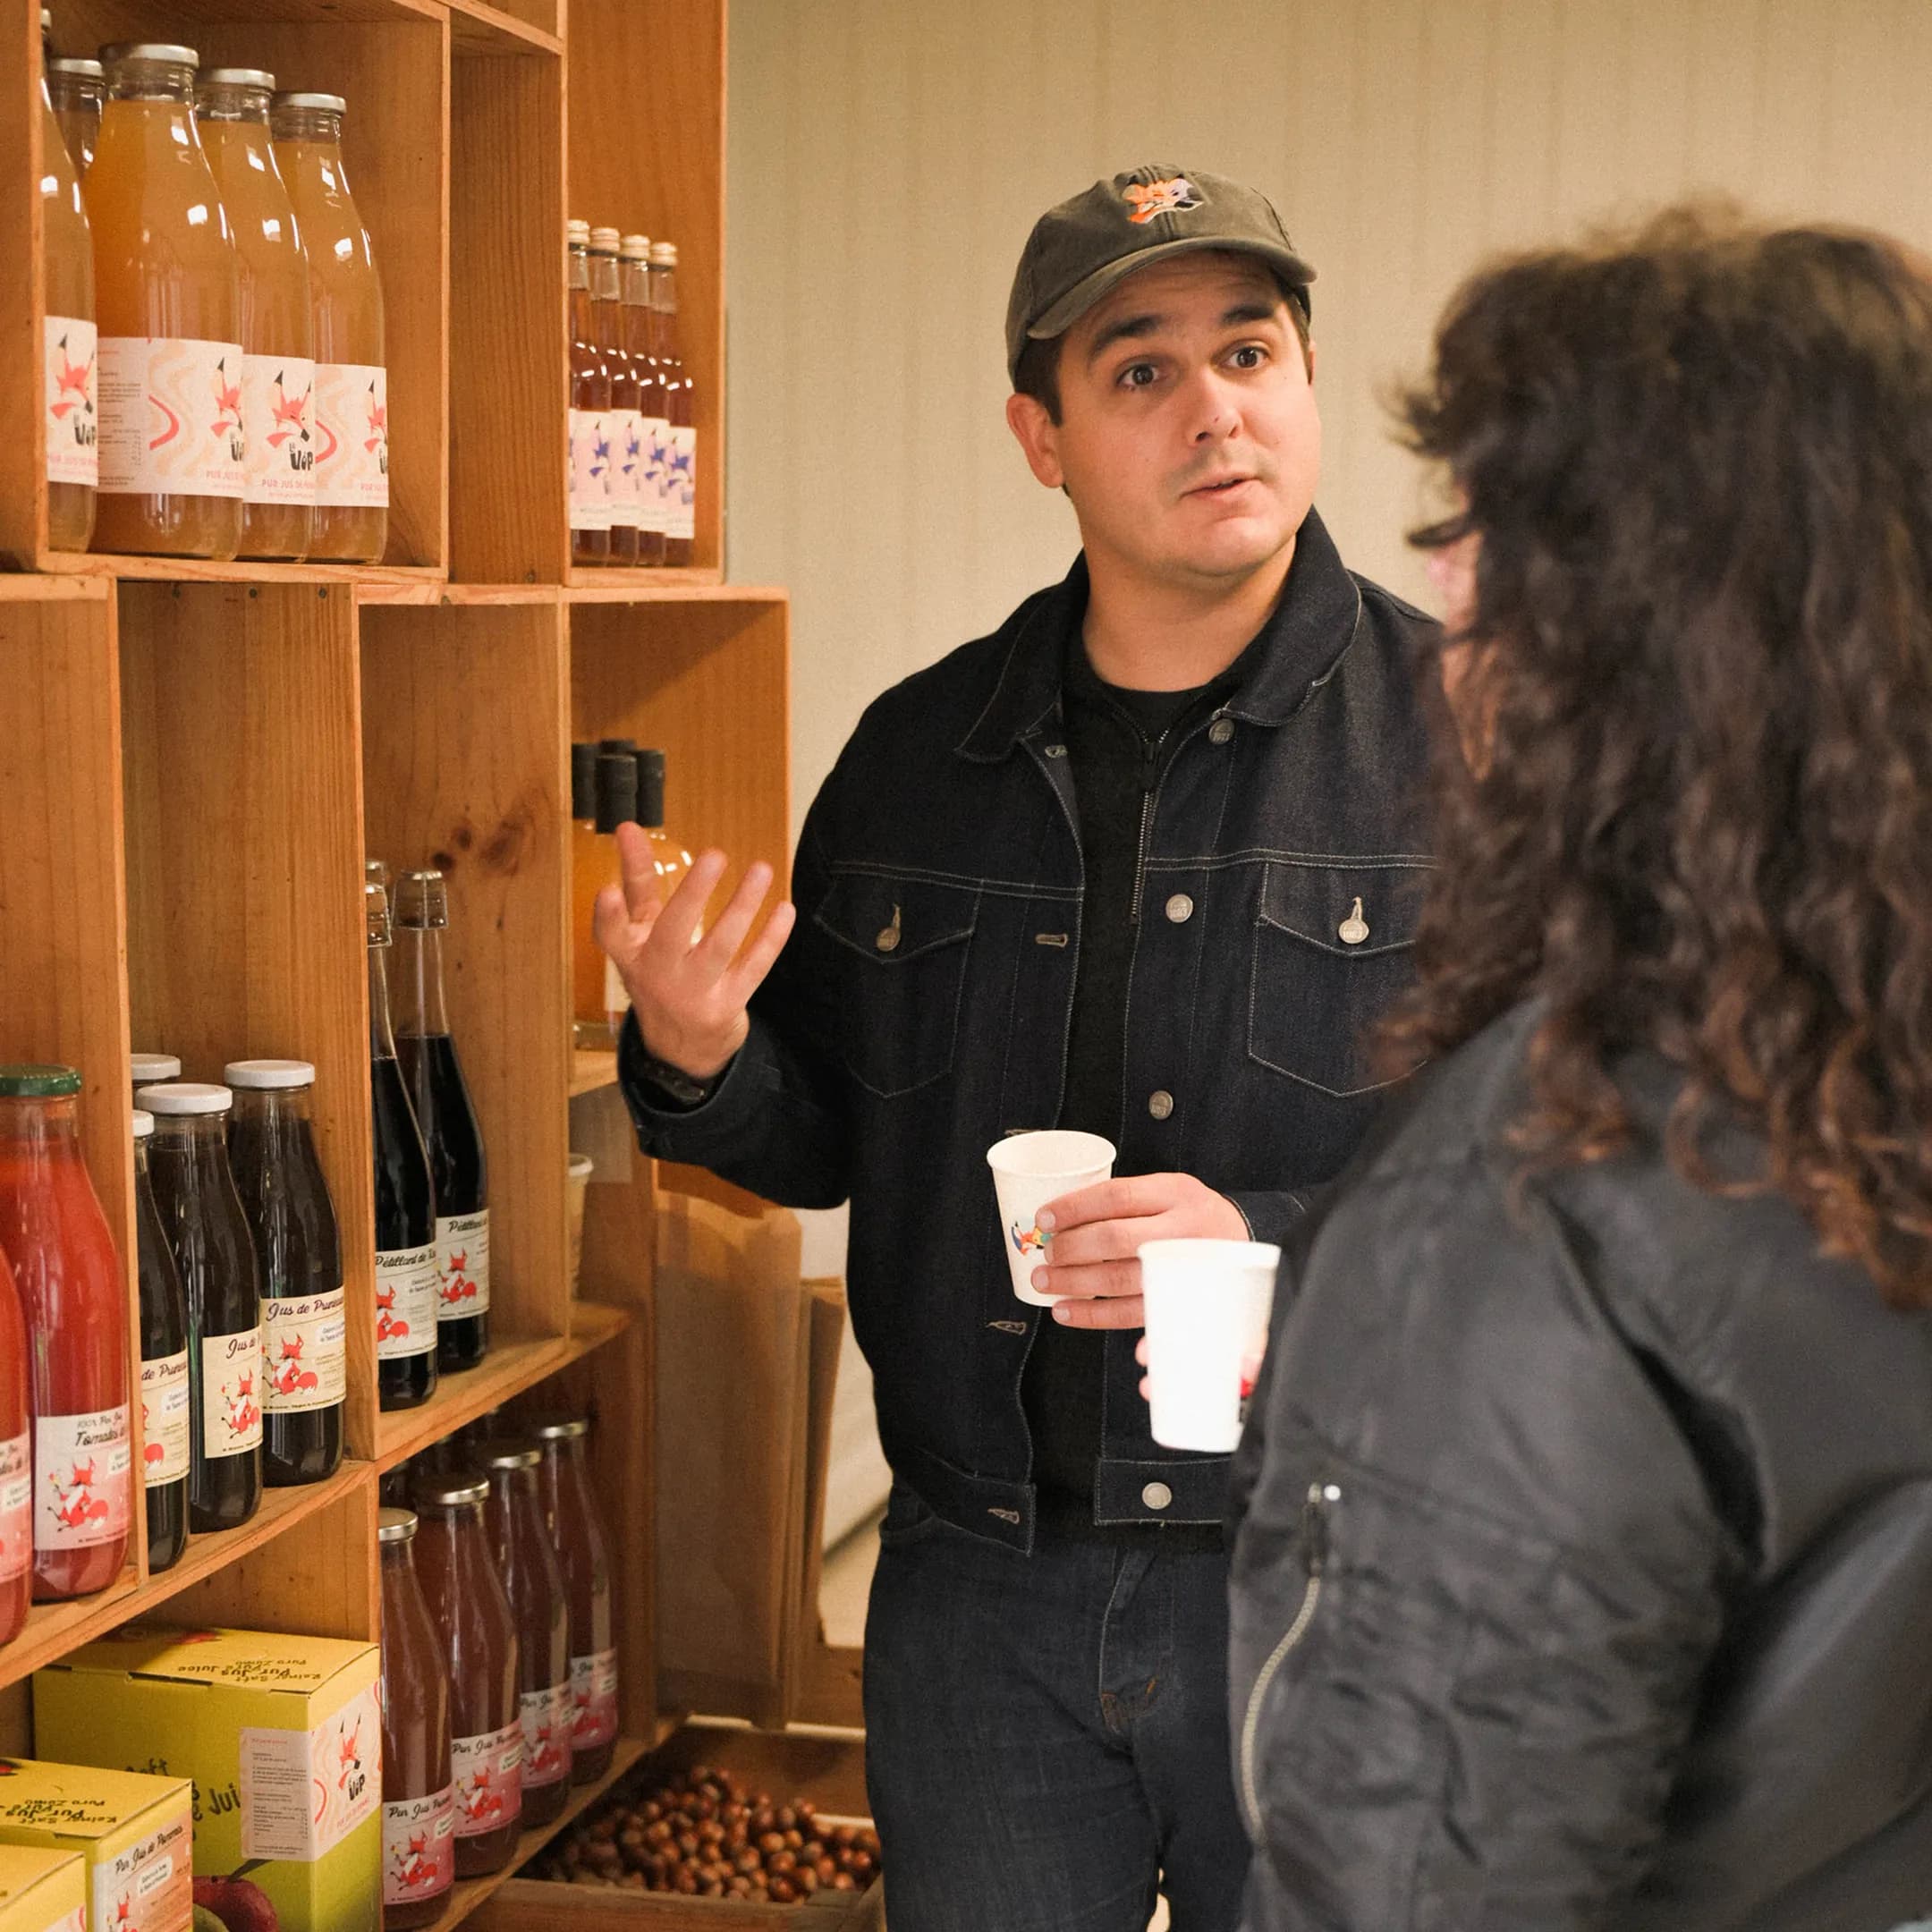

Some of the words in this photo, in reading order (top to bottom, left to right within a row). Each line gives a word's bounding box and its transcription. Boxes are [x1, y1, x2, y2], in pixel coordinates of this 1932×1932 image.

[266, 1302, 293, 1322] Jus
[296, 1304, 309, 1314] de
[225, 1338, 248, 1359] Jus
[178, 1665, 220, 1674] Juice
[388, 1806, 408, 1818] Pur
